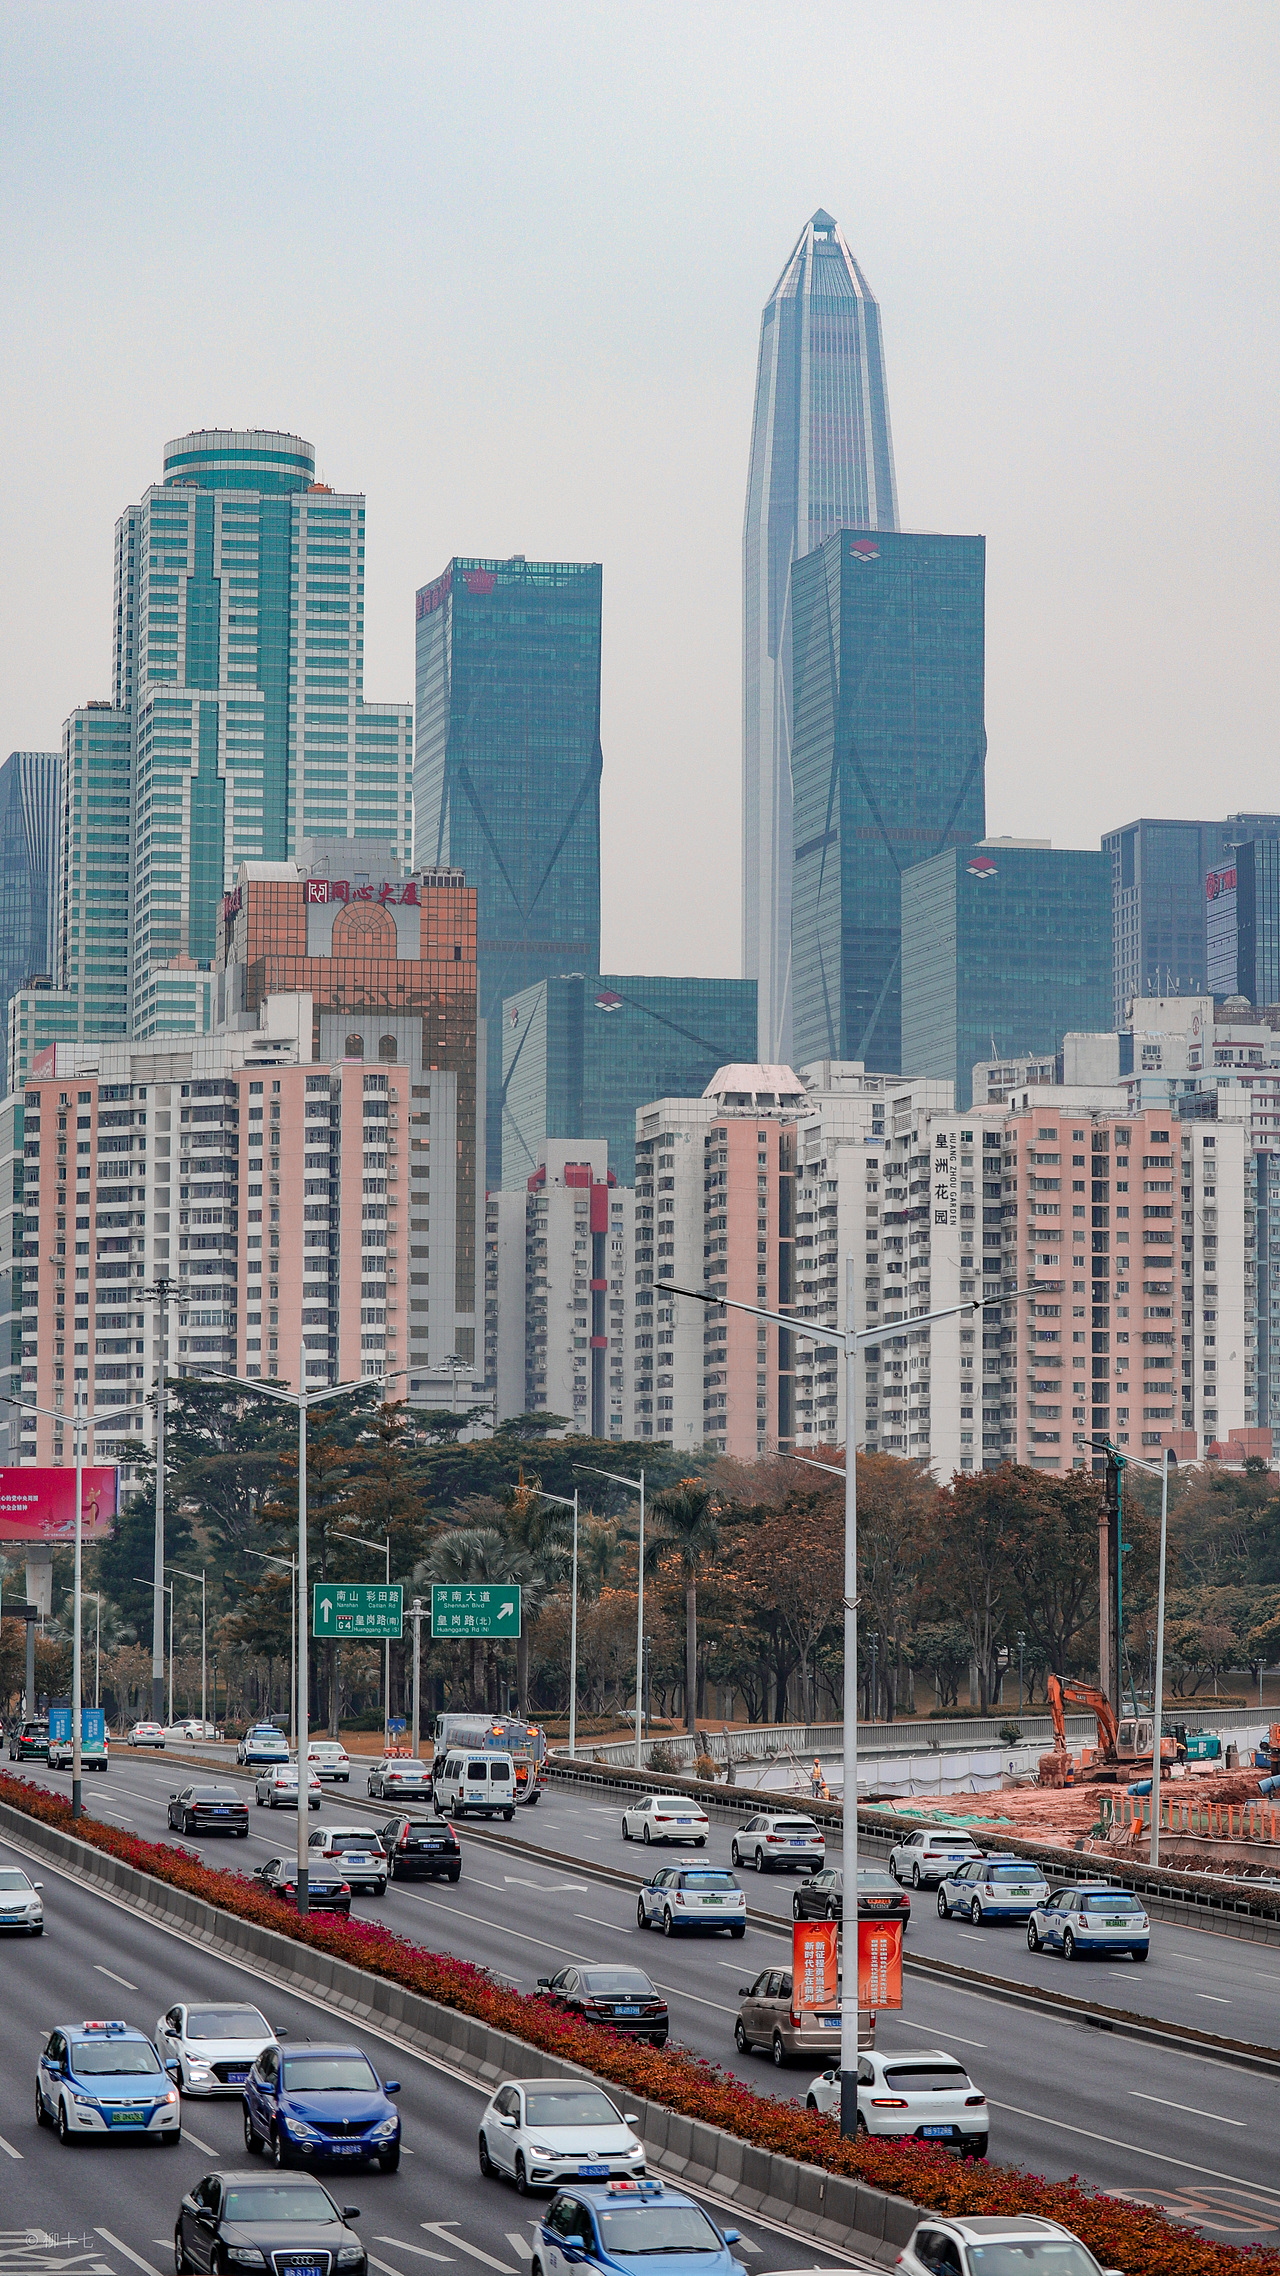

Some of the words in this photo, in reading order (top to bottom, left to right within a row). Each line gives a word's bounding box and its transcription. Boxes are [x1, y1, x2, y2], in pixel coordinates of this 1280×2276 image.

[332, 880, 421, 907] 同心大厦
[949, 1132, 957, 1162] HUANG
[935, 1133, 949, 1225] 皇洲花园
[949, 1166, 957, 1188] ZHOU
[949, 1191, 957, 1226] GARDEN
[337, 1590, 359, 1602] 南山
[366, 1590, 399, 1602] 彩田路
[437, 1590, 491, 1602] 深南大道
[338, 1621, 351, 1630] G4
[804, 1941, 814, 2003] 新时代走在前列
[815, 1941, 825, 2003] 新征程勇当尖兵
